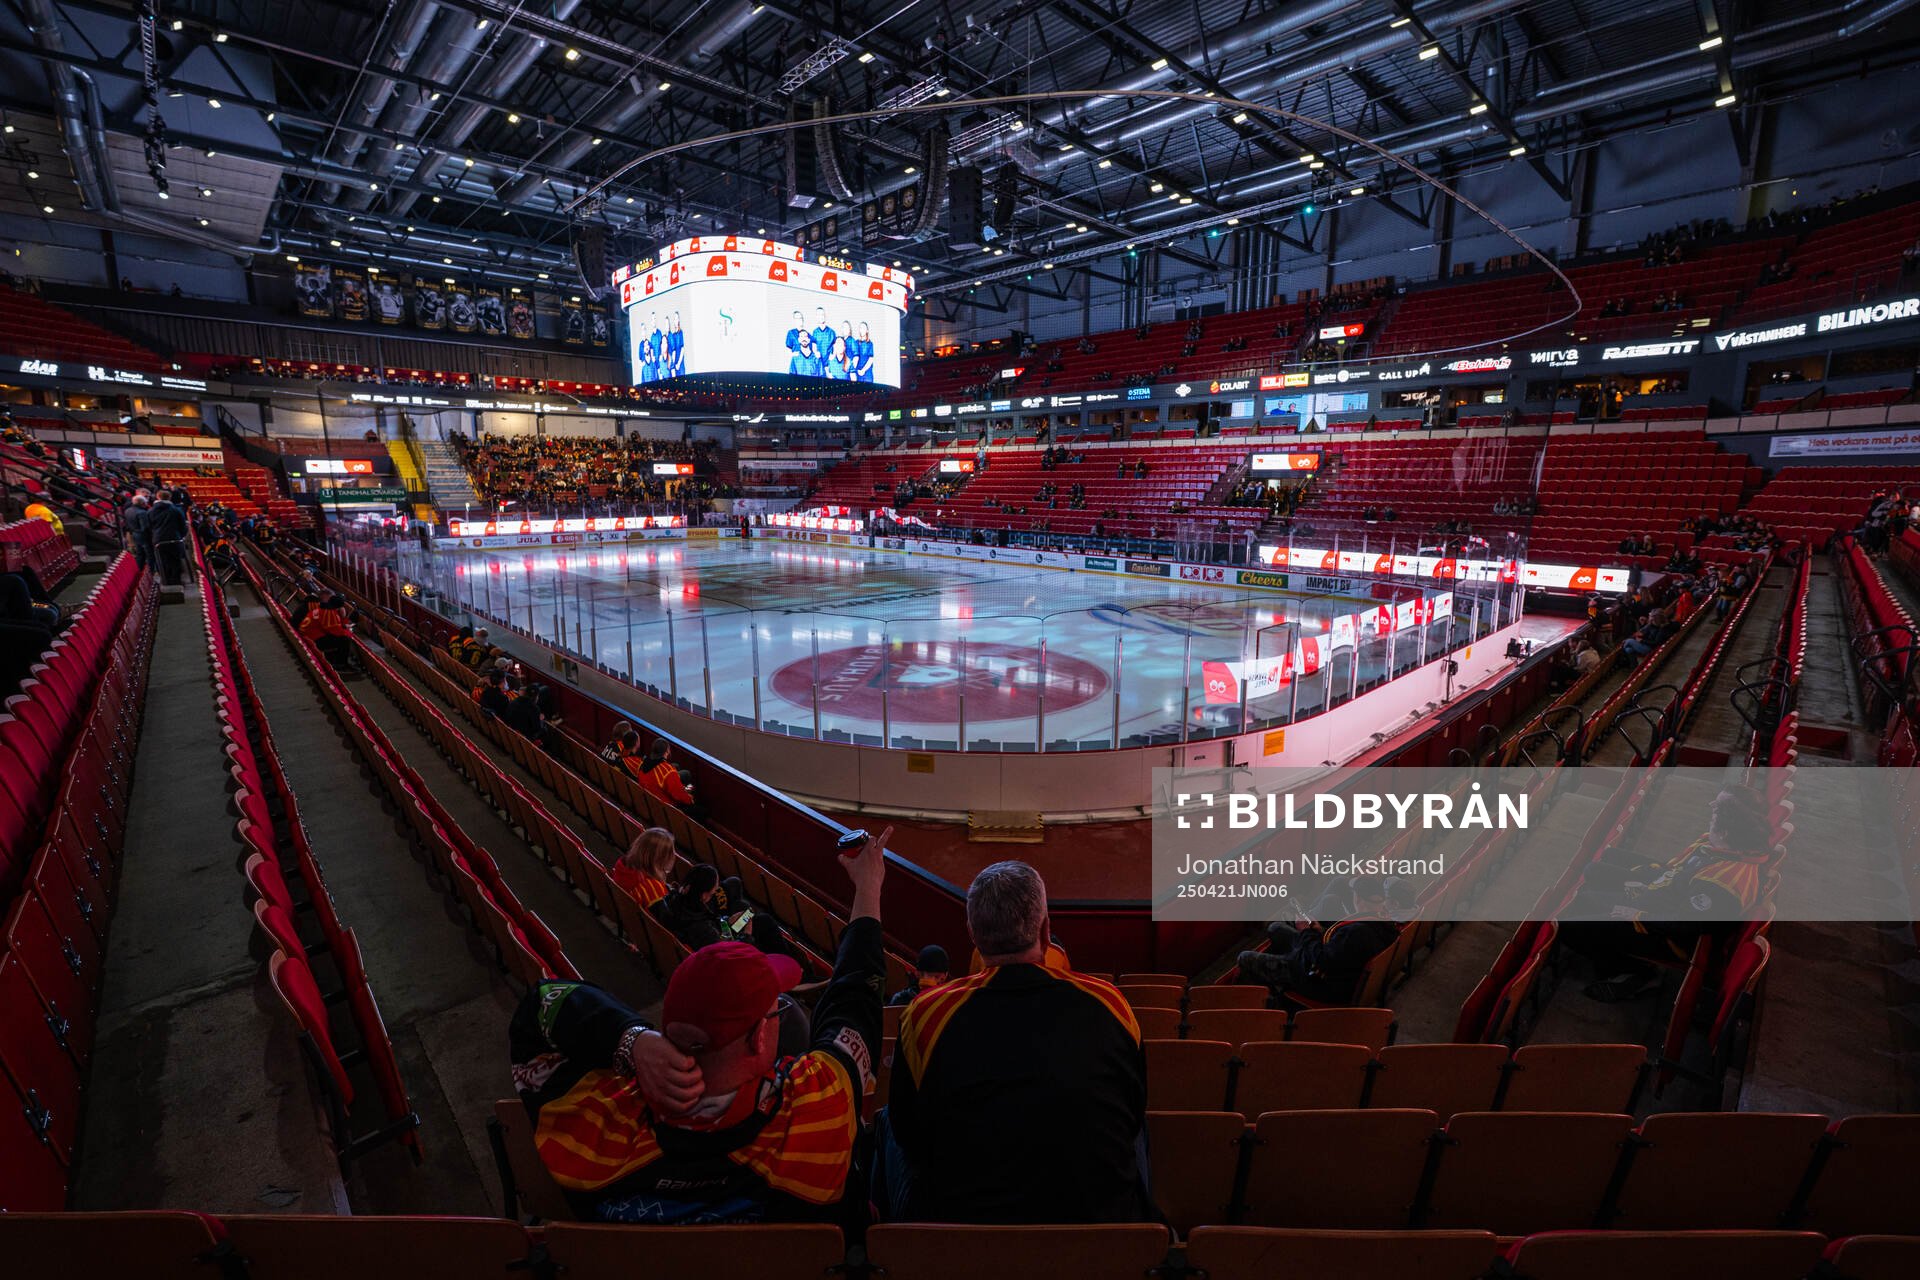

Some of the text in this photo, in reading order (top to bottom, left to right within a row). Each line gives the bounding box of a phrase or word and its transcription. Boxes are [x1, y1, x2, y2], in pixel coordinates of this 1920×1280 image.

[1731, 323, 1807, 347] VÄSTANHEDE
[1379, 371, 1402, 380] CALL
[1405, 369, 1418, 378] UP
[1220, 381, 1250, 391] COLABIT
[1831, 437, 1869, 447] veckans
[1872, 435, 1892, 444] mat
[1241, 571, 1283, 587] Cheers
[1306, 576, 1338, 590] IMPACT
